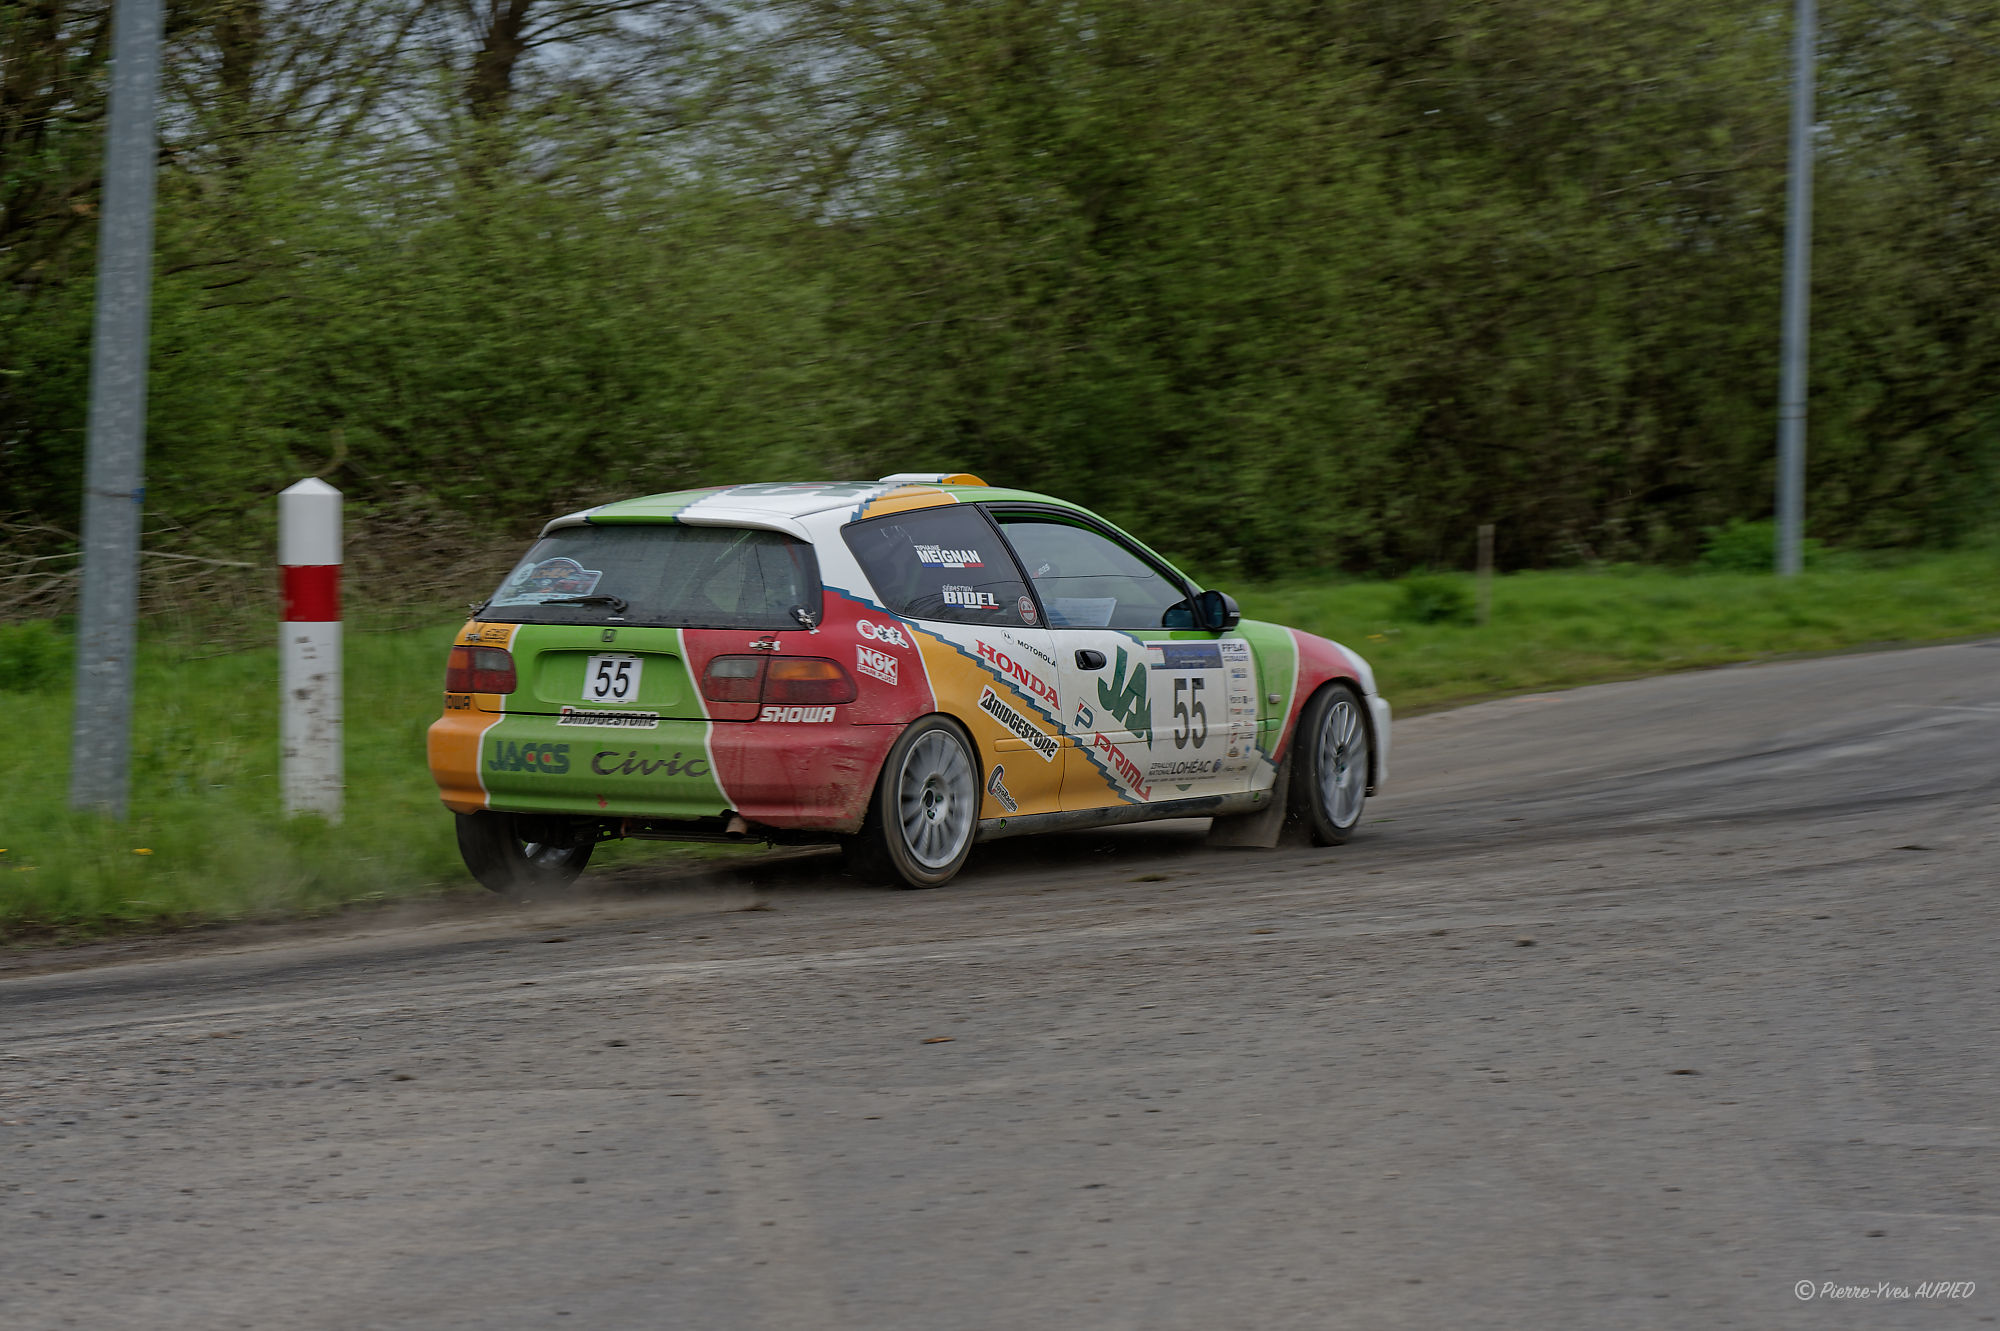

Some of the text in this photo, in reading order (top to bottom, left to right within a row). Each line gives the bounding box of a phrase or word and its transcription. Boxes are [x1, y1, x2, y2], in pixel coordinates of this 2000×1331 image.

[916, 550, 981, 563] MEIGNAN
[943, 592, 999, 606] BIDEL
[857, 647, 896, 677] NGK
[1017, 640, 1056, 668] MOTOROLA
[595, 661, 632, 698] 55
[976, 640, 1060, 711] HONDA
[561, 708, 657, 727] BRIDGESTONE
[760, 707, 836, 722] SHOWA
[980, 688, 1059, 758] BRIDGESTONE
[1174, 677, 1207, 750] 55
[489, 741, 570, 774] JACCS
[591, 751, 710, 777] Civic
[1171, 759, 1211, 775] LOHÉAC
